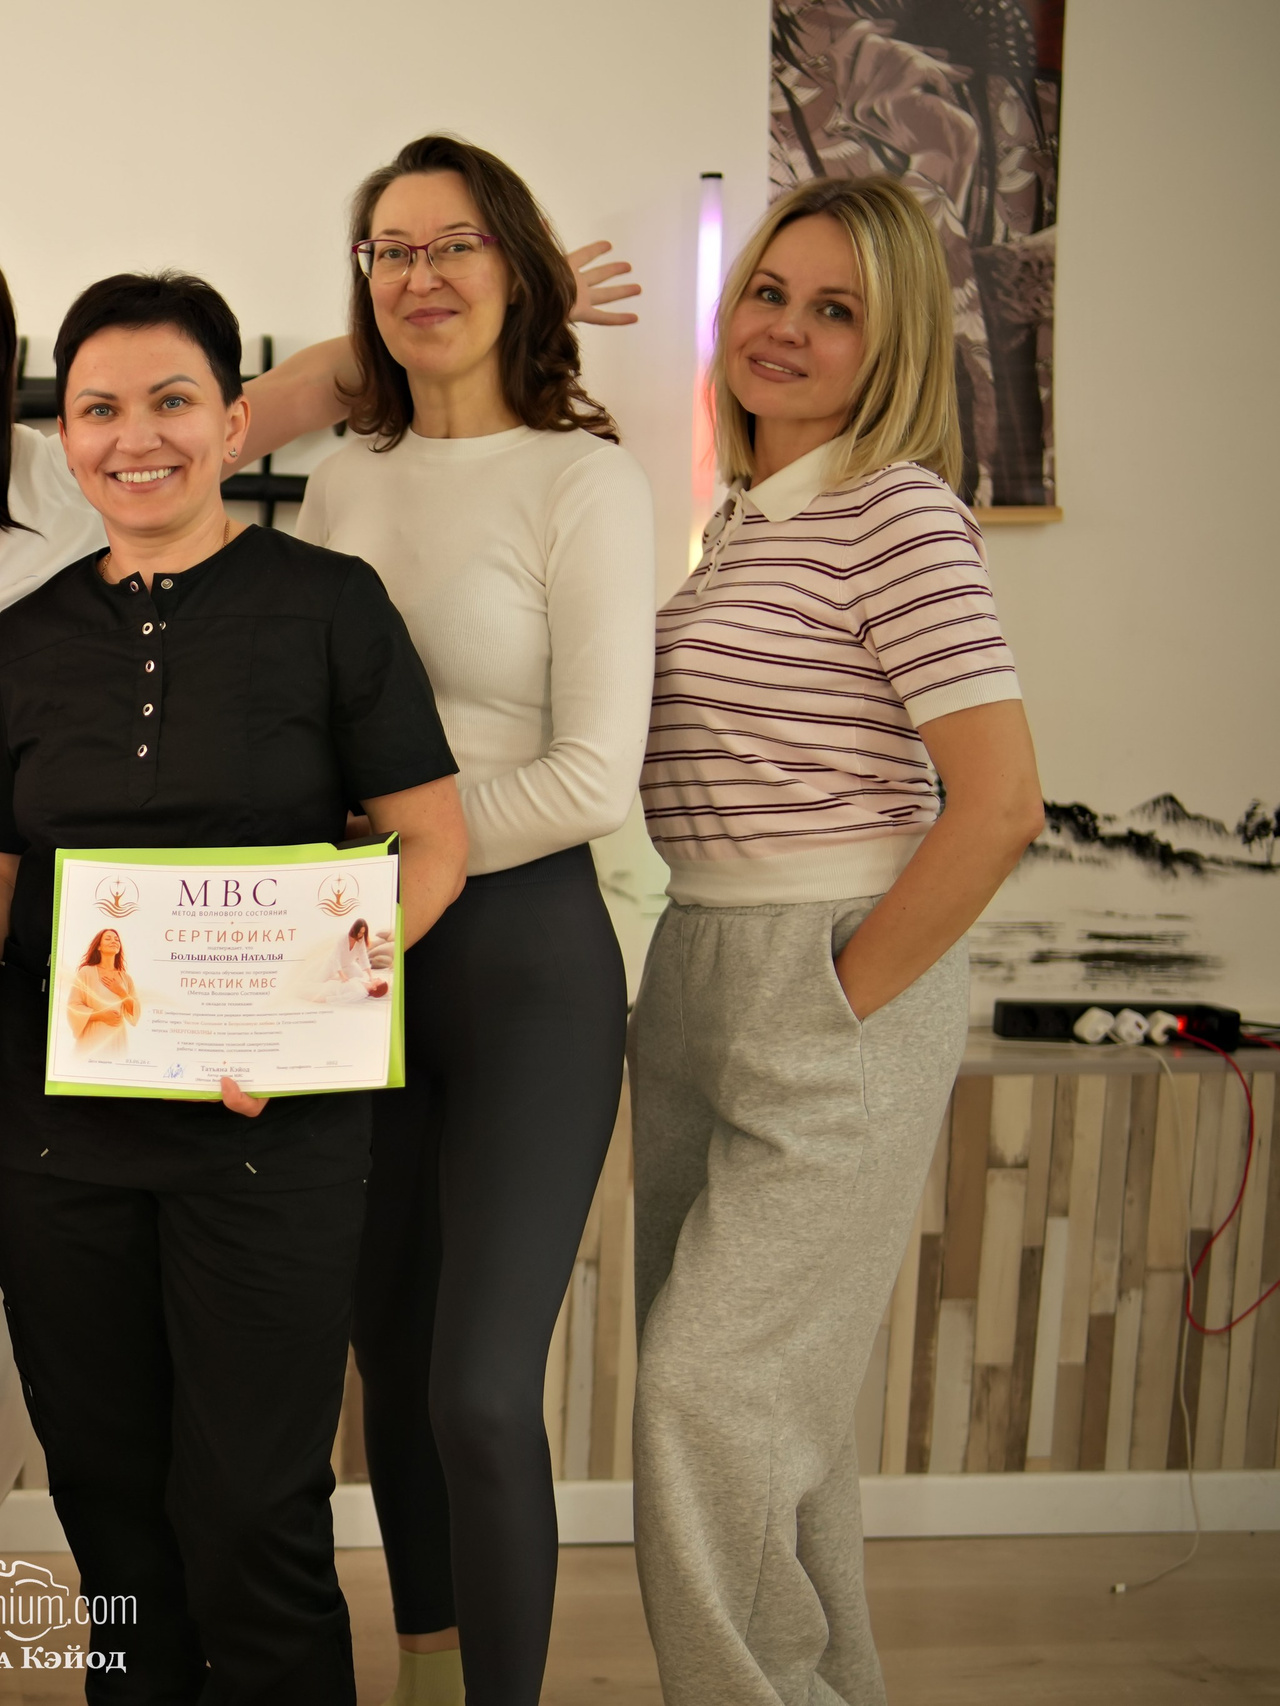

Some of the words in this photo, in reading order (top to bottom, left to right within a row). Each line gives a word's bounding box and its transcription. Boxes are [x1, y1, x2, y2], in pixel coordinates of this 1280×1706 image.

[177, 878, 278, 907] МВС
[164, 928, 297, 943] СЕРТИФИКАТ
[180, 978, 243, 988] ПРАКТИК
[249, 978, 277, 988] МВС
